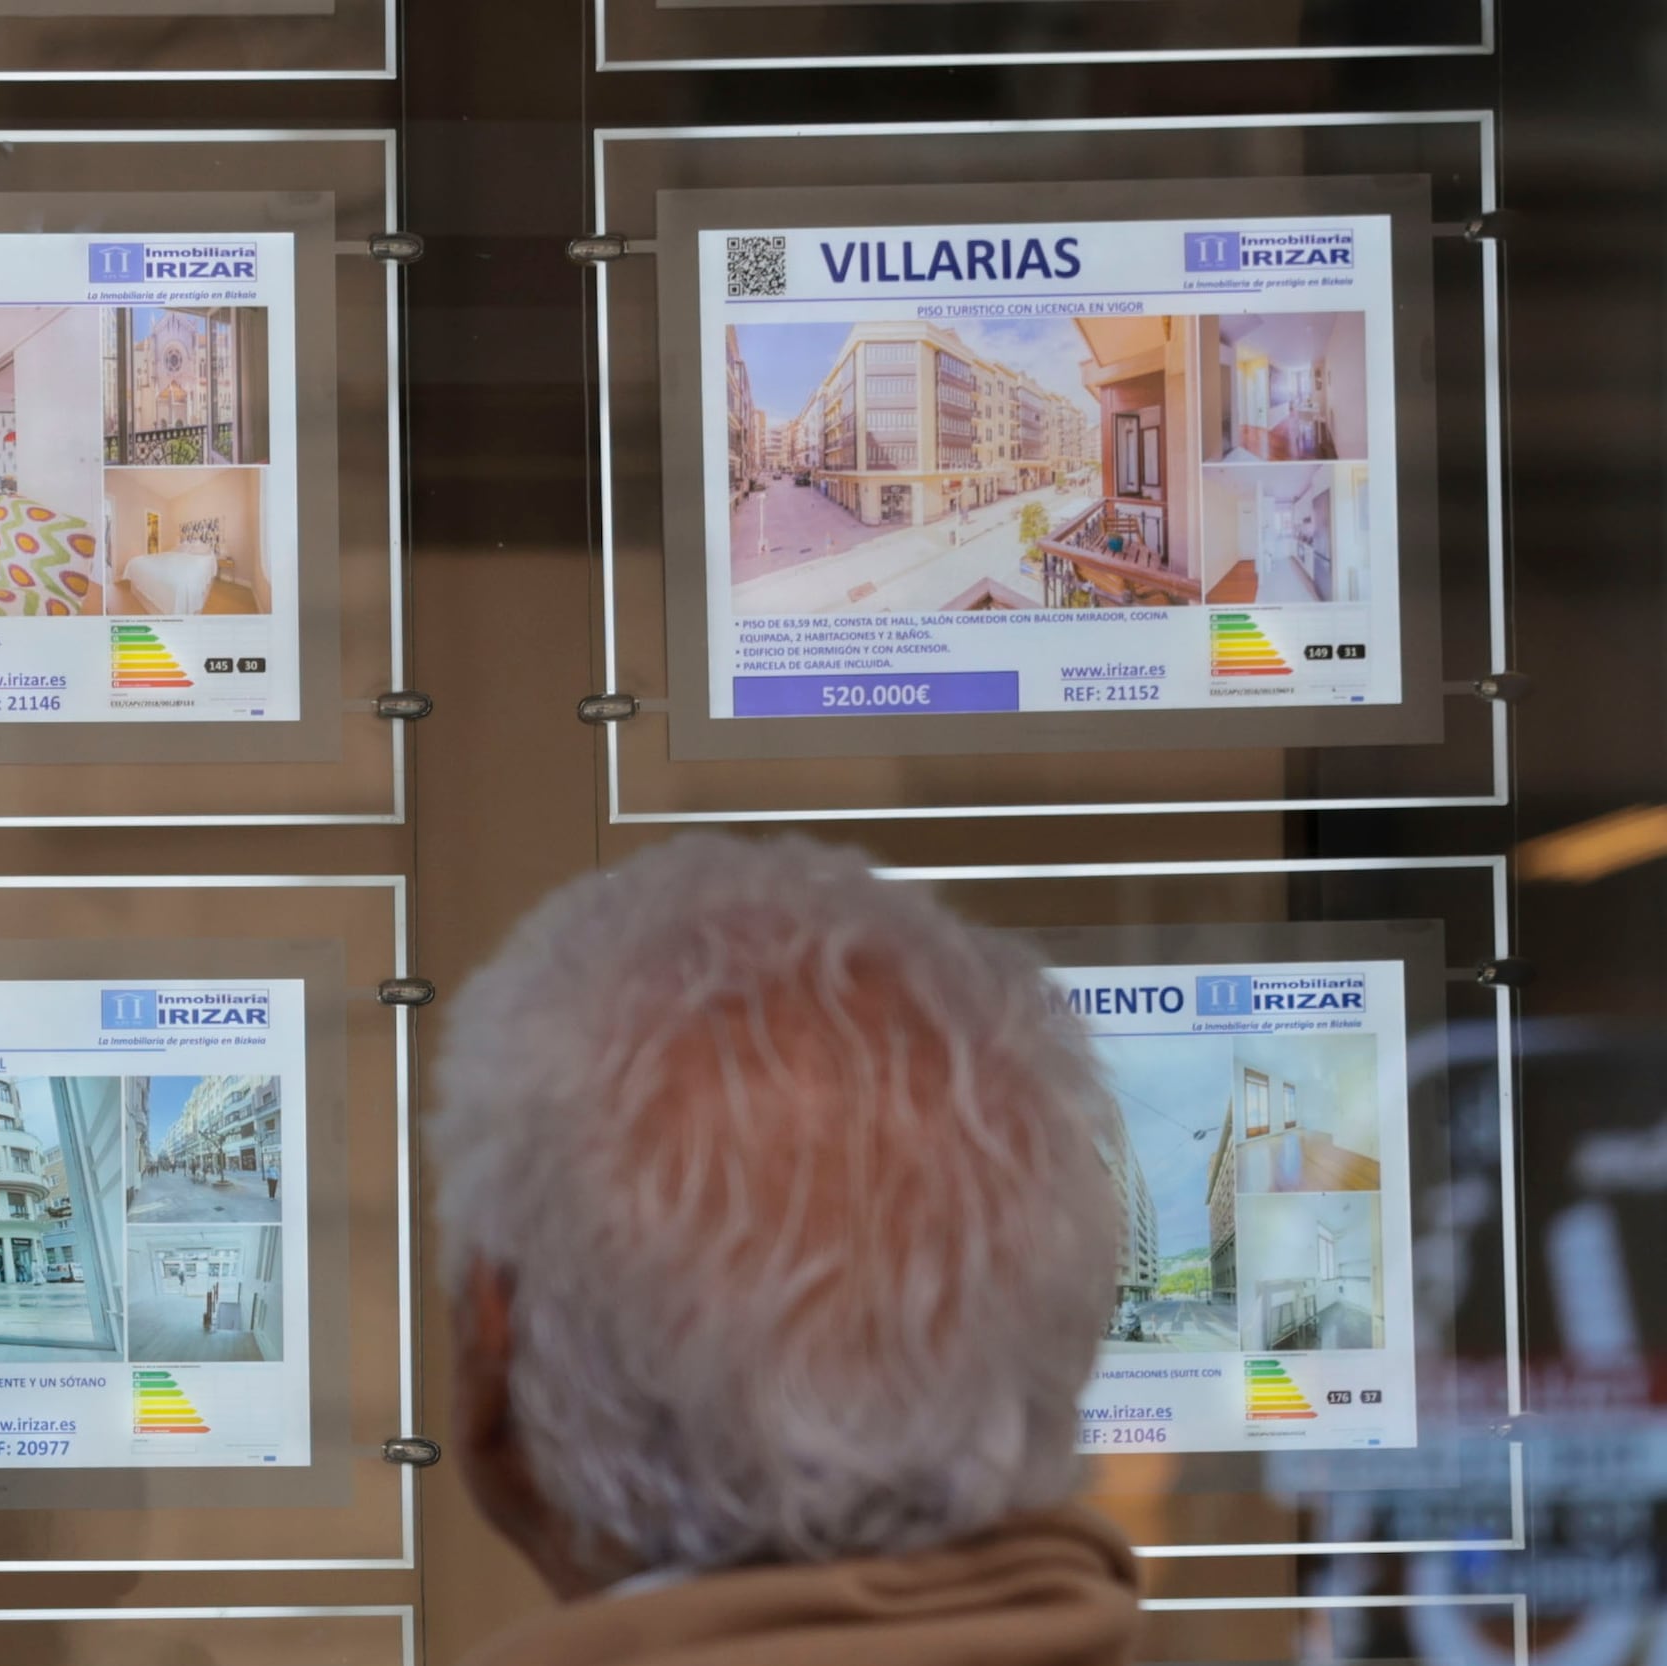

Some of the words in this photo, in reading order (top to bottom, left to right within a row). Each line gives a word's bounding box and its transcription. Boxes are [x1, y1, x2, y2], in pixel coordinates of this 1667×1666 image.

[1240, 233, 1352, 246] Inmobiliaria
[145, 246, 255, 258] Inmobiliaria
[819, 236, 1081, 284] VILLARIAS
[1241, 247, 1350, 266] IRIZAR
[145, 261, 254, 278] IRIZAR
[209, 660, 228, 671] 145
[244, 660, 258, 671] 30
[1060, 661, 1166, 679] www.irizar.es
[821, 683, 930, 707] 520.000€
[1063, 685, 1100, 702] REF:
[1105, 684, 1159, 701] 21152
[7, 694, 61, 711] 21146
[1253, 977, 1364, 990] Inmobiliaria
[157, 993, 268, 1005] Inmobiliaria
[1050, 986, 1184, 1015] MIENTO
[1253, 991, 1362, 1011] IRIZAR
[158, 1007, 267, 1025] IRIZAR
[1077, 1405, 1173, 1419] ww.irizar.es
[1079, 1428, 1107, 1444] EF:
[1113, 1428, 1167, 1443] 21046
[16, 1439, 70, 1456] 20977
